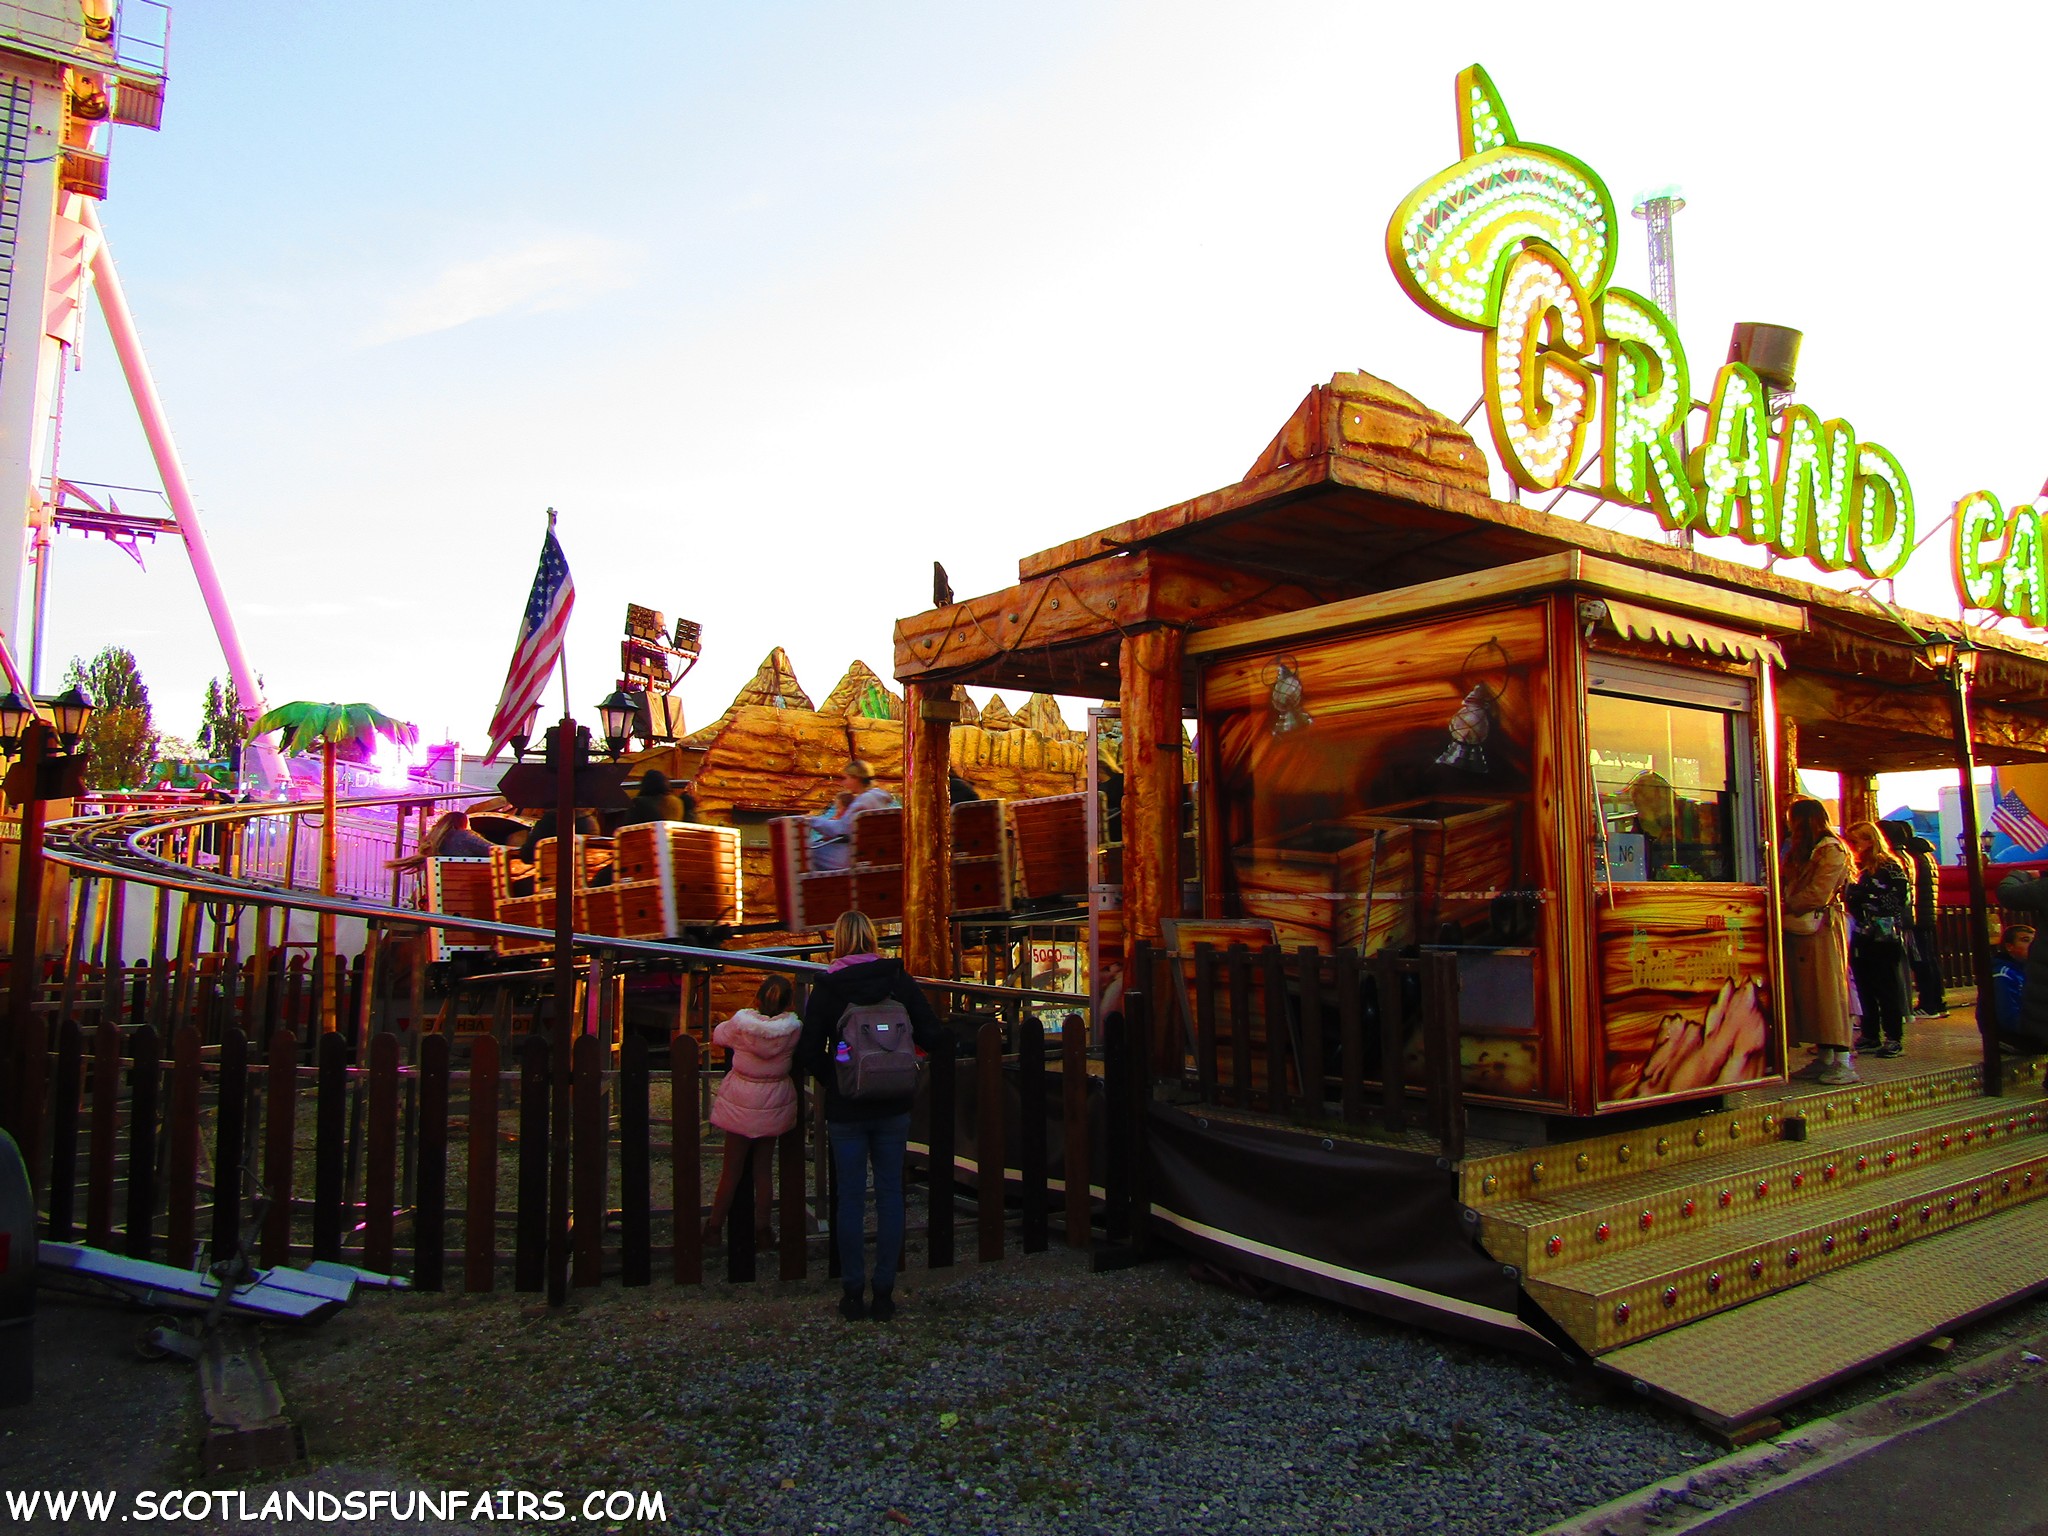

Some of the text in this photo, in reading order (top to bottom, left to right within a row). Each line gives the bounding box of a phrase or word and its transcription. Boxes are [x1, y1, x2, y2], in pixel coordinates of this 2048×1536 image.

[1483, 243, 2048, 629] GRAND CA
[1619, 844, 1634, 862] N6
